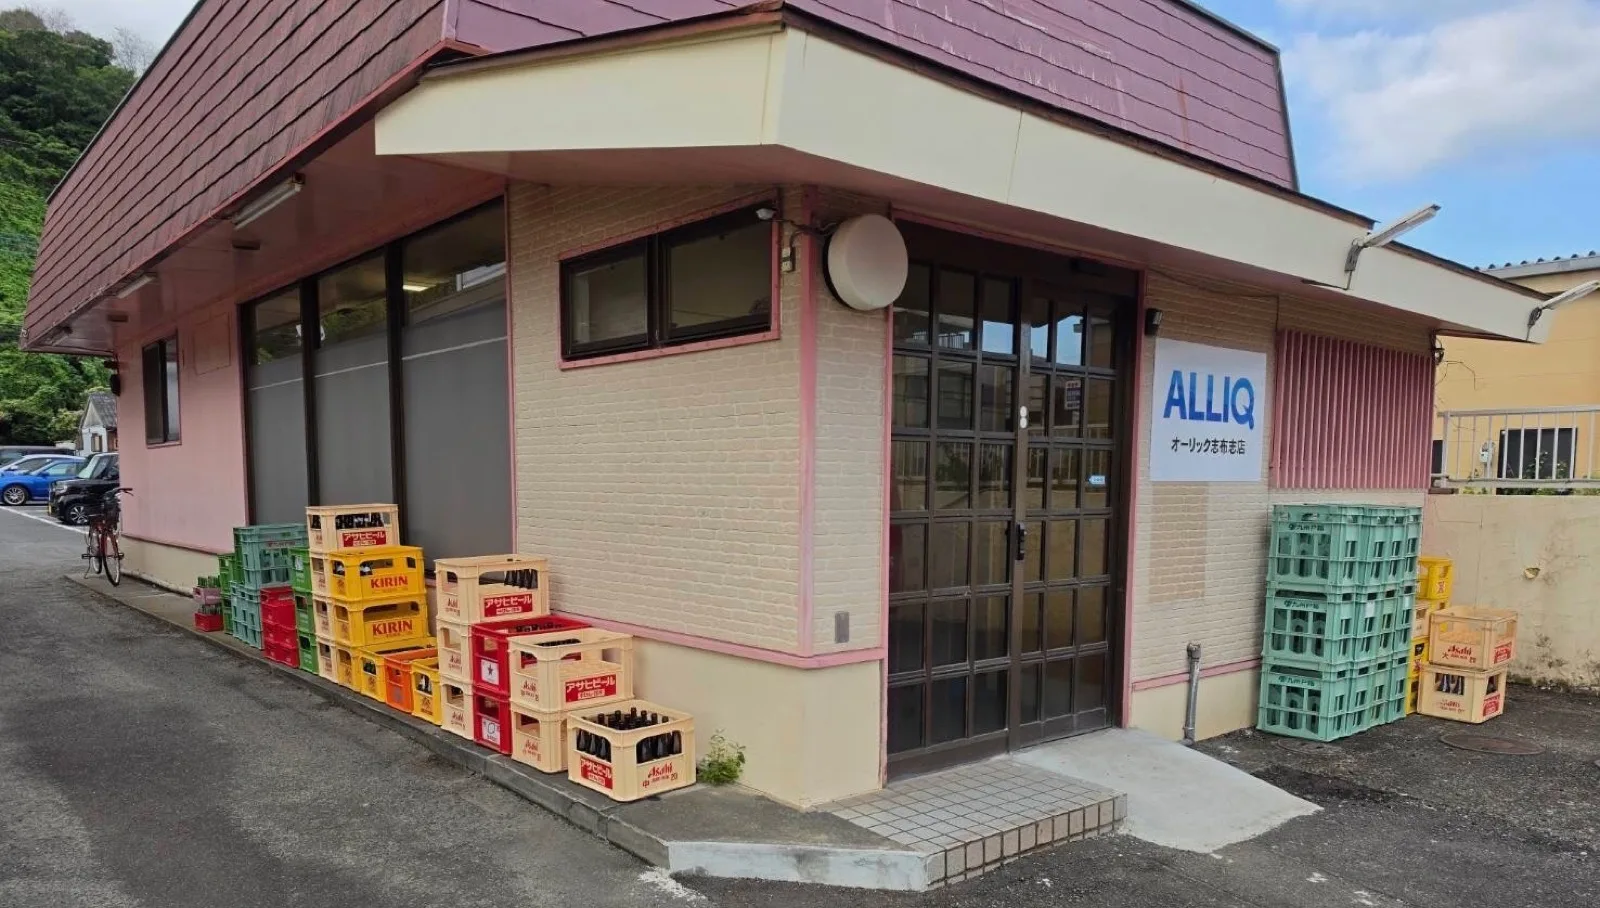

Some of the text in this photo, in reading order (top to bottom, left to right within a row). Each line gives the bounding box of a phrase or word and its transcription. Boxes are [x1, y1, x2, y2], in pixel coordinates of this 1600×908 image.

[1163, 370, 1254, 430] ALLIQ
[1171, 437, 1246, 454] オーリック志布志店
[344, 531, 385, 541] アサヒビール
[370, 575, 408, 588] KIRIN
[485, 595, 532, 609] アサヒビール
[372, 619, 413, 636] KIRIN
[1447, 645, 1472, 656] Asahi
[566, 675, 616, 694] アサヒビール
[581, 758, 612, 779] アサヒビール
[647, 762, 673, 778] Asahi
